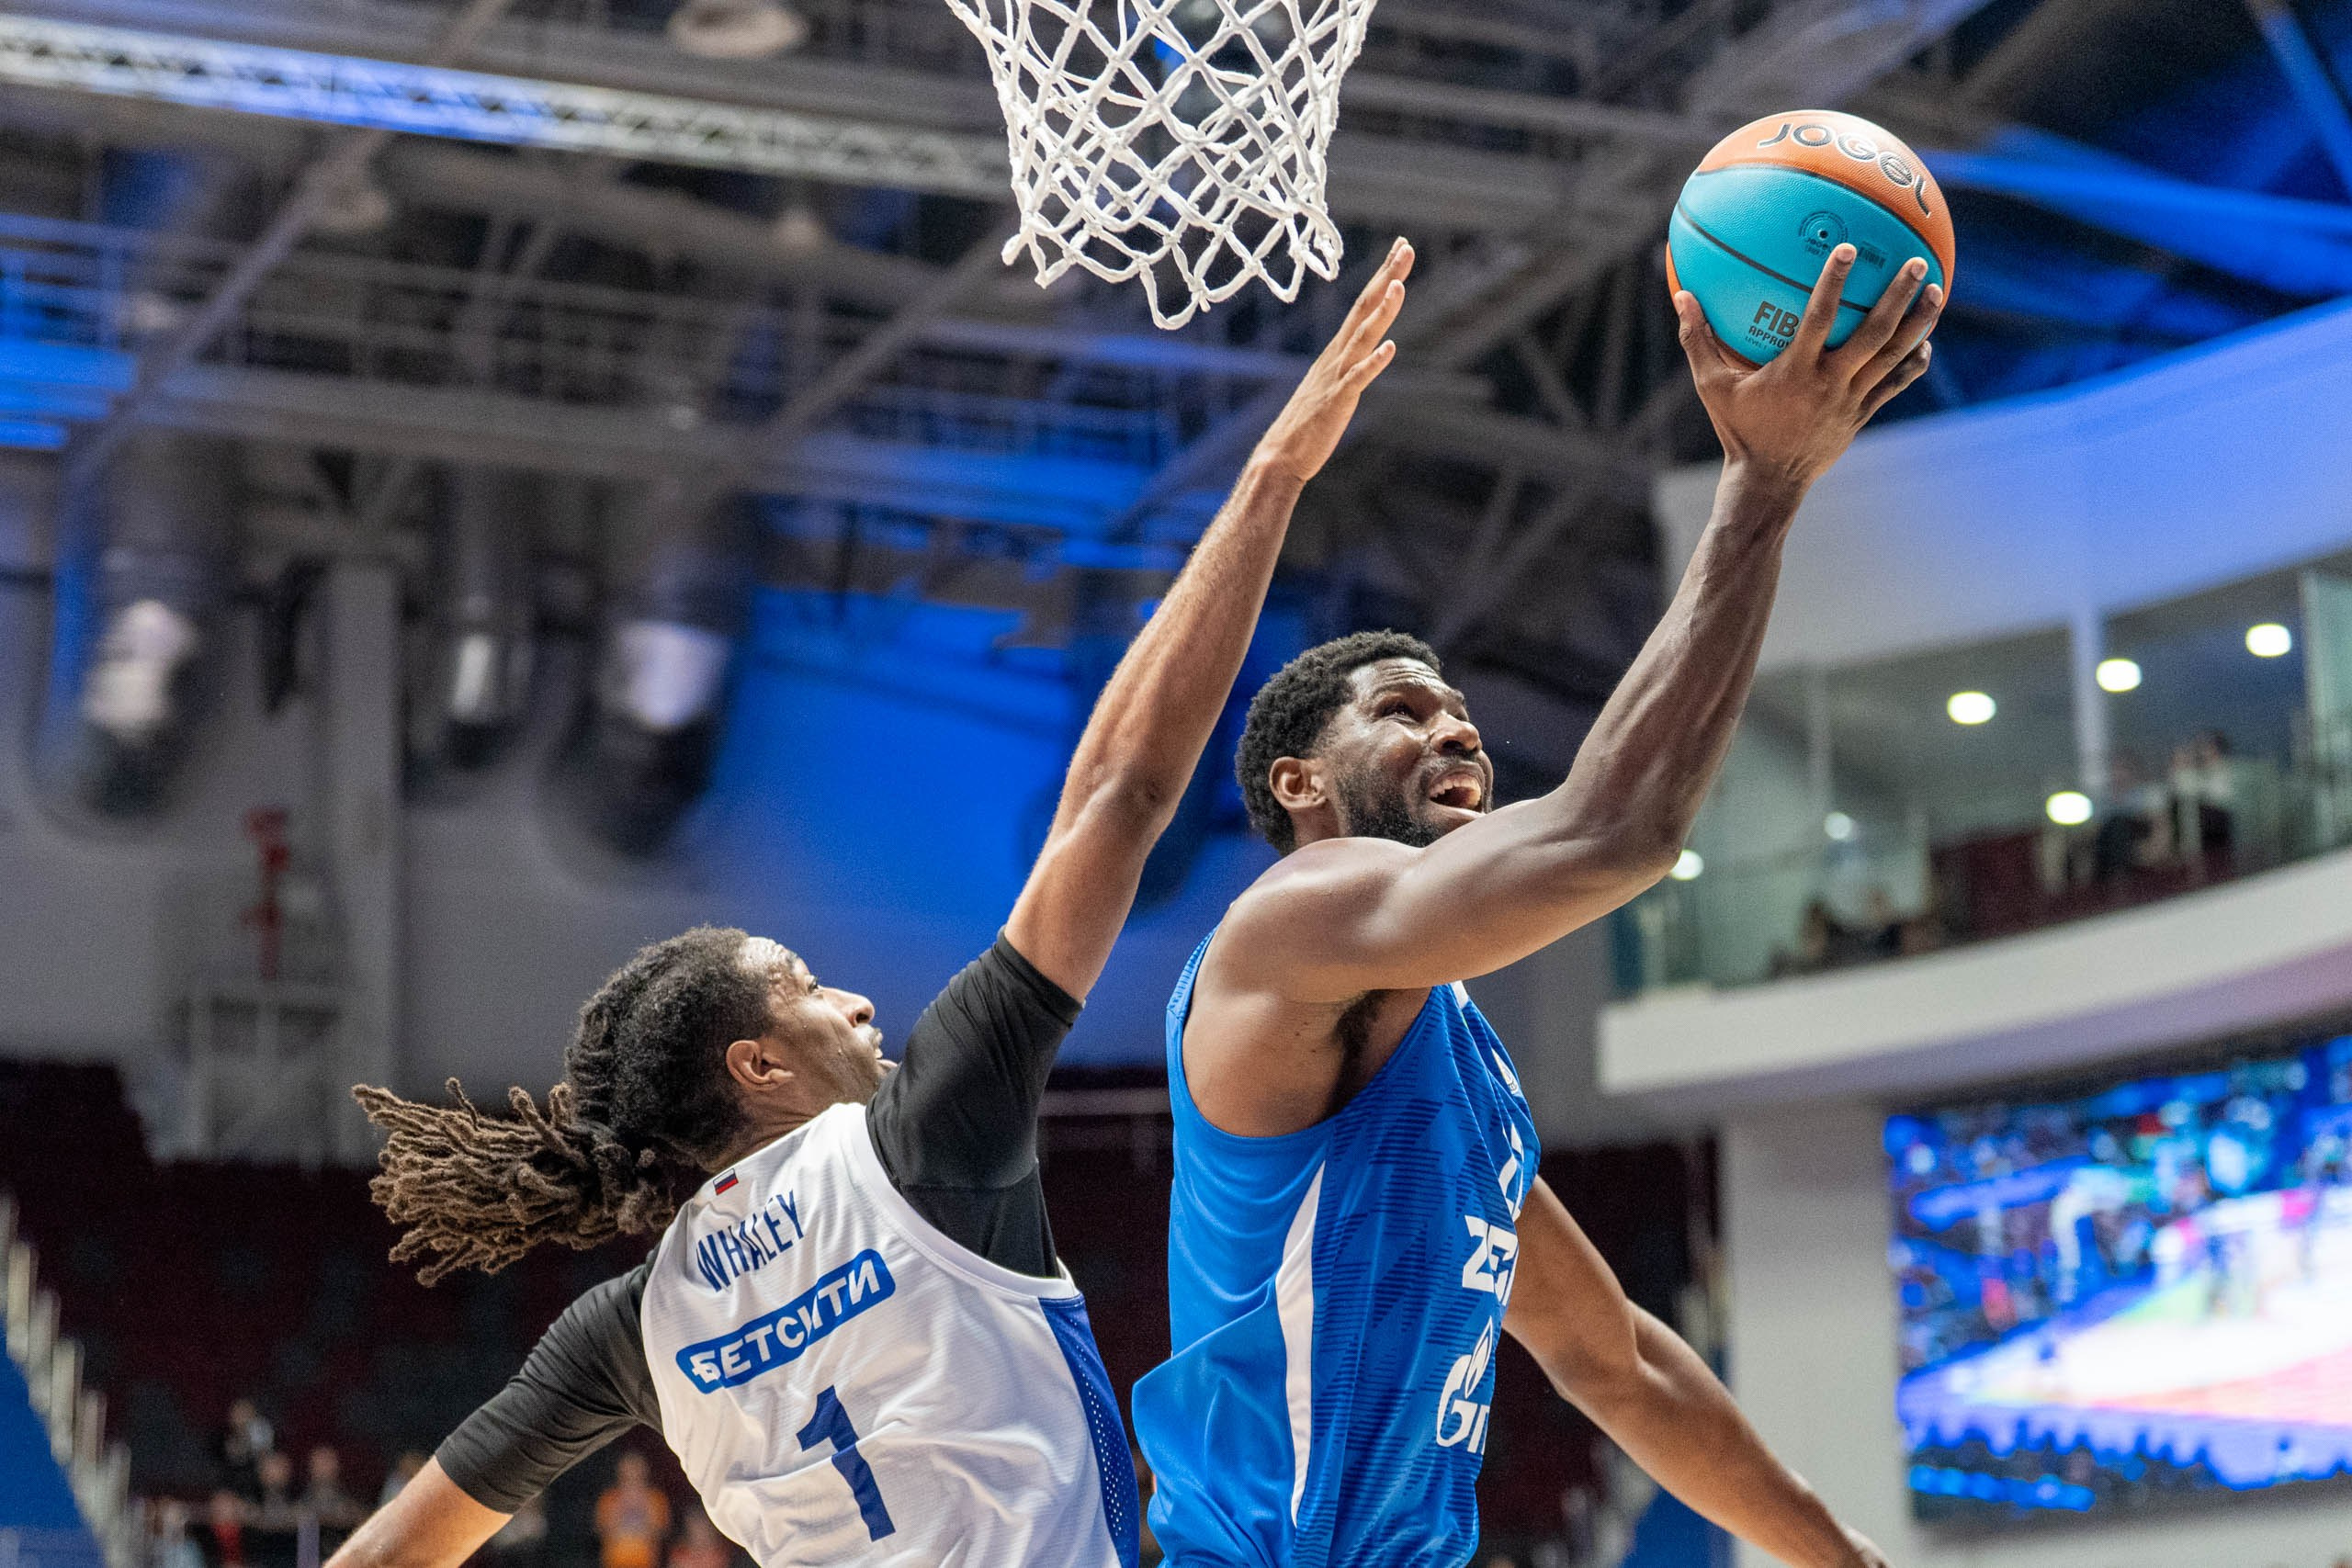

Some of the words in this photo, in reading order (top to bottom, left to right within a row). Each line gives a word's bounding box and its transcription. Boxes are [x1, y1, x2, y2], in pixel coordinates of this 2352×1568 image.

[1757, 122, 1932, 220] JOGEL
[1753, 300, 1800, 338] FIB
[696, 1190, 805, 1292] WHALEY
[1462, 1214, 1520, 1307] ZE
[689, 1258, 881, 1383] БЕТСИТИ
[796, 1384, 897, 1542] 1
